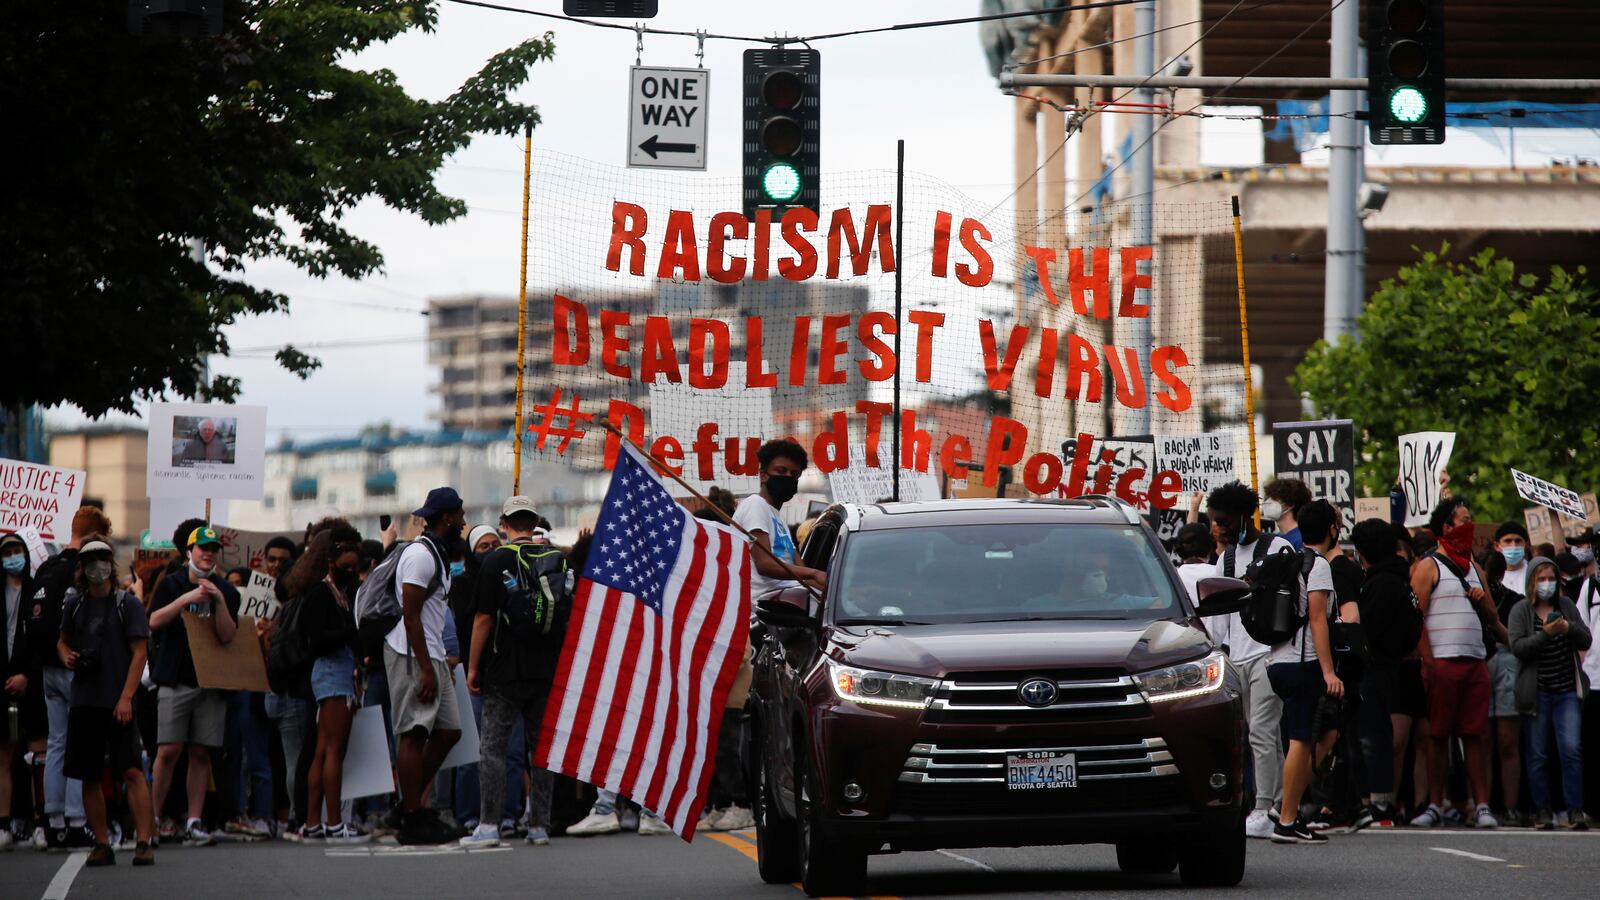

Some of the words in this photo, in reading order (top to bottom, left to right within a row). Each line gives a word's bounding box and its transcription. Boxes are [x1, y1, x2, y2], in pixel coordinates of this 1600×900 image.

[641, 77, 698, 100] ONE
[641, 103, 698, 127] WAY
[605, 200, 896, 283] RACISM
[931, 210, 994, 288] IS
[1024, 245, 1153, 320] THE
[552, 294, 946, 390] DEADLIEST
[979, 319, 1193, 413] VIRUS
[528, 387, 1183, 510] #DefudThePolice
[1061, 440, 1148, 470] BACK
[1165, 438, 1201, 456] RACISM
[1210, 436, 1219, 450] IS
[1287, 429, 1338, 466] SAY
[1160, 458, 1166, 472] A
[1171, 455, 1200, 474] PUBLIC
[1203, 455, 1233, 473] HEALTH
[65, 473, 75, 497] 4
[1182, 476, 1208, 492] RISIS
[1403, 440, 1443, 517] BLM
[0, 490, 59, 513] REONNA
[1008, 782, 1035, 790] TOYOTA
[1047, 781, 1077, 789] SEATTLE
